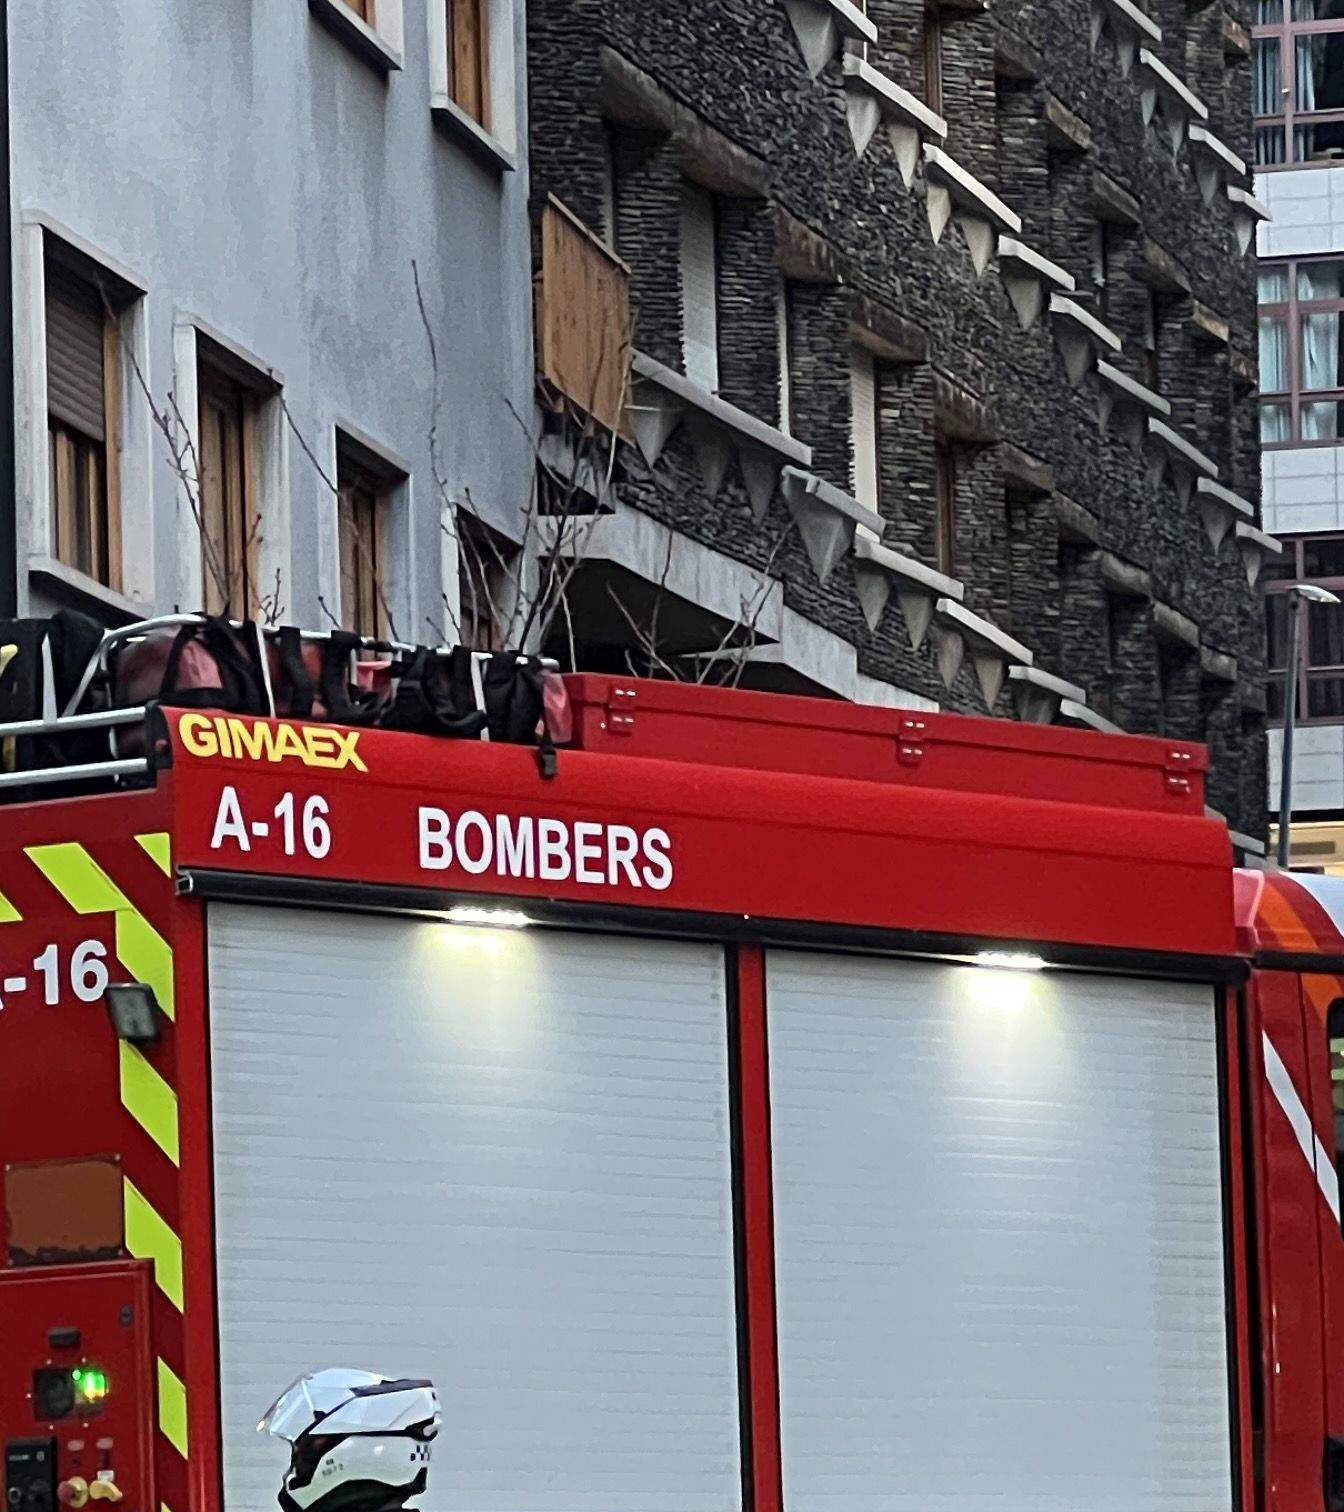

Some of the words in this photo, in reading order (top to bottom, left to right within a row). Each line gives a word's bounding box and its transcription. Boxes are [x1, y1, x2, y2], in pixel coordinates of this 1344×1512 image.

[178, 713, 368, 773] GIMAEX
[210, 786, 331, 859] A-16
[418, 806, 673, 890] BOMBERS
